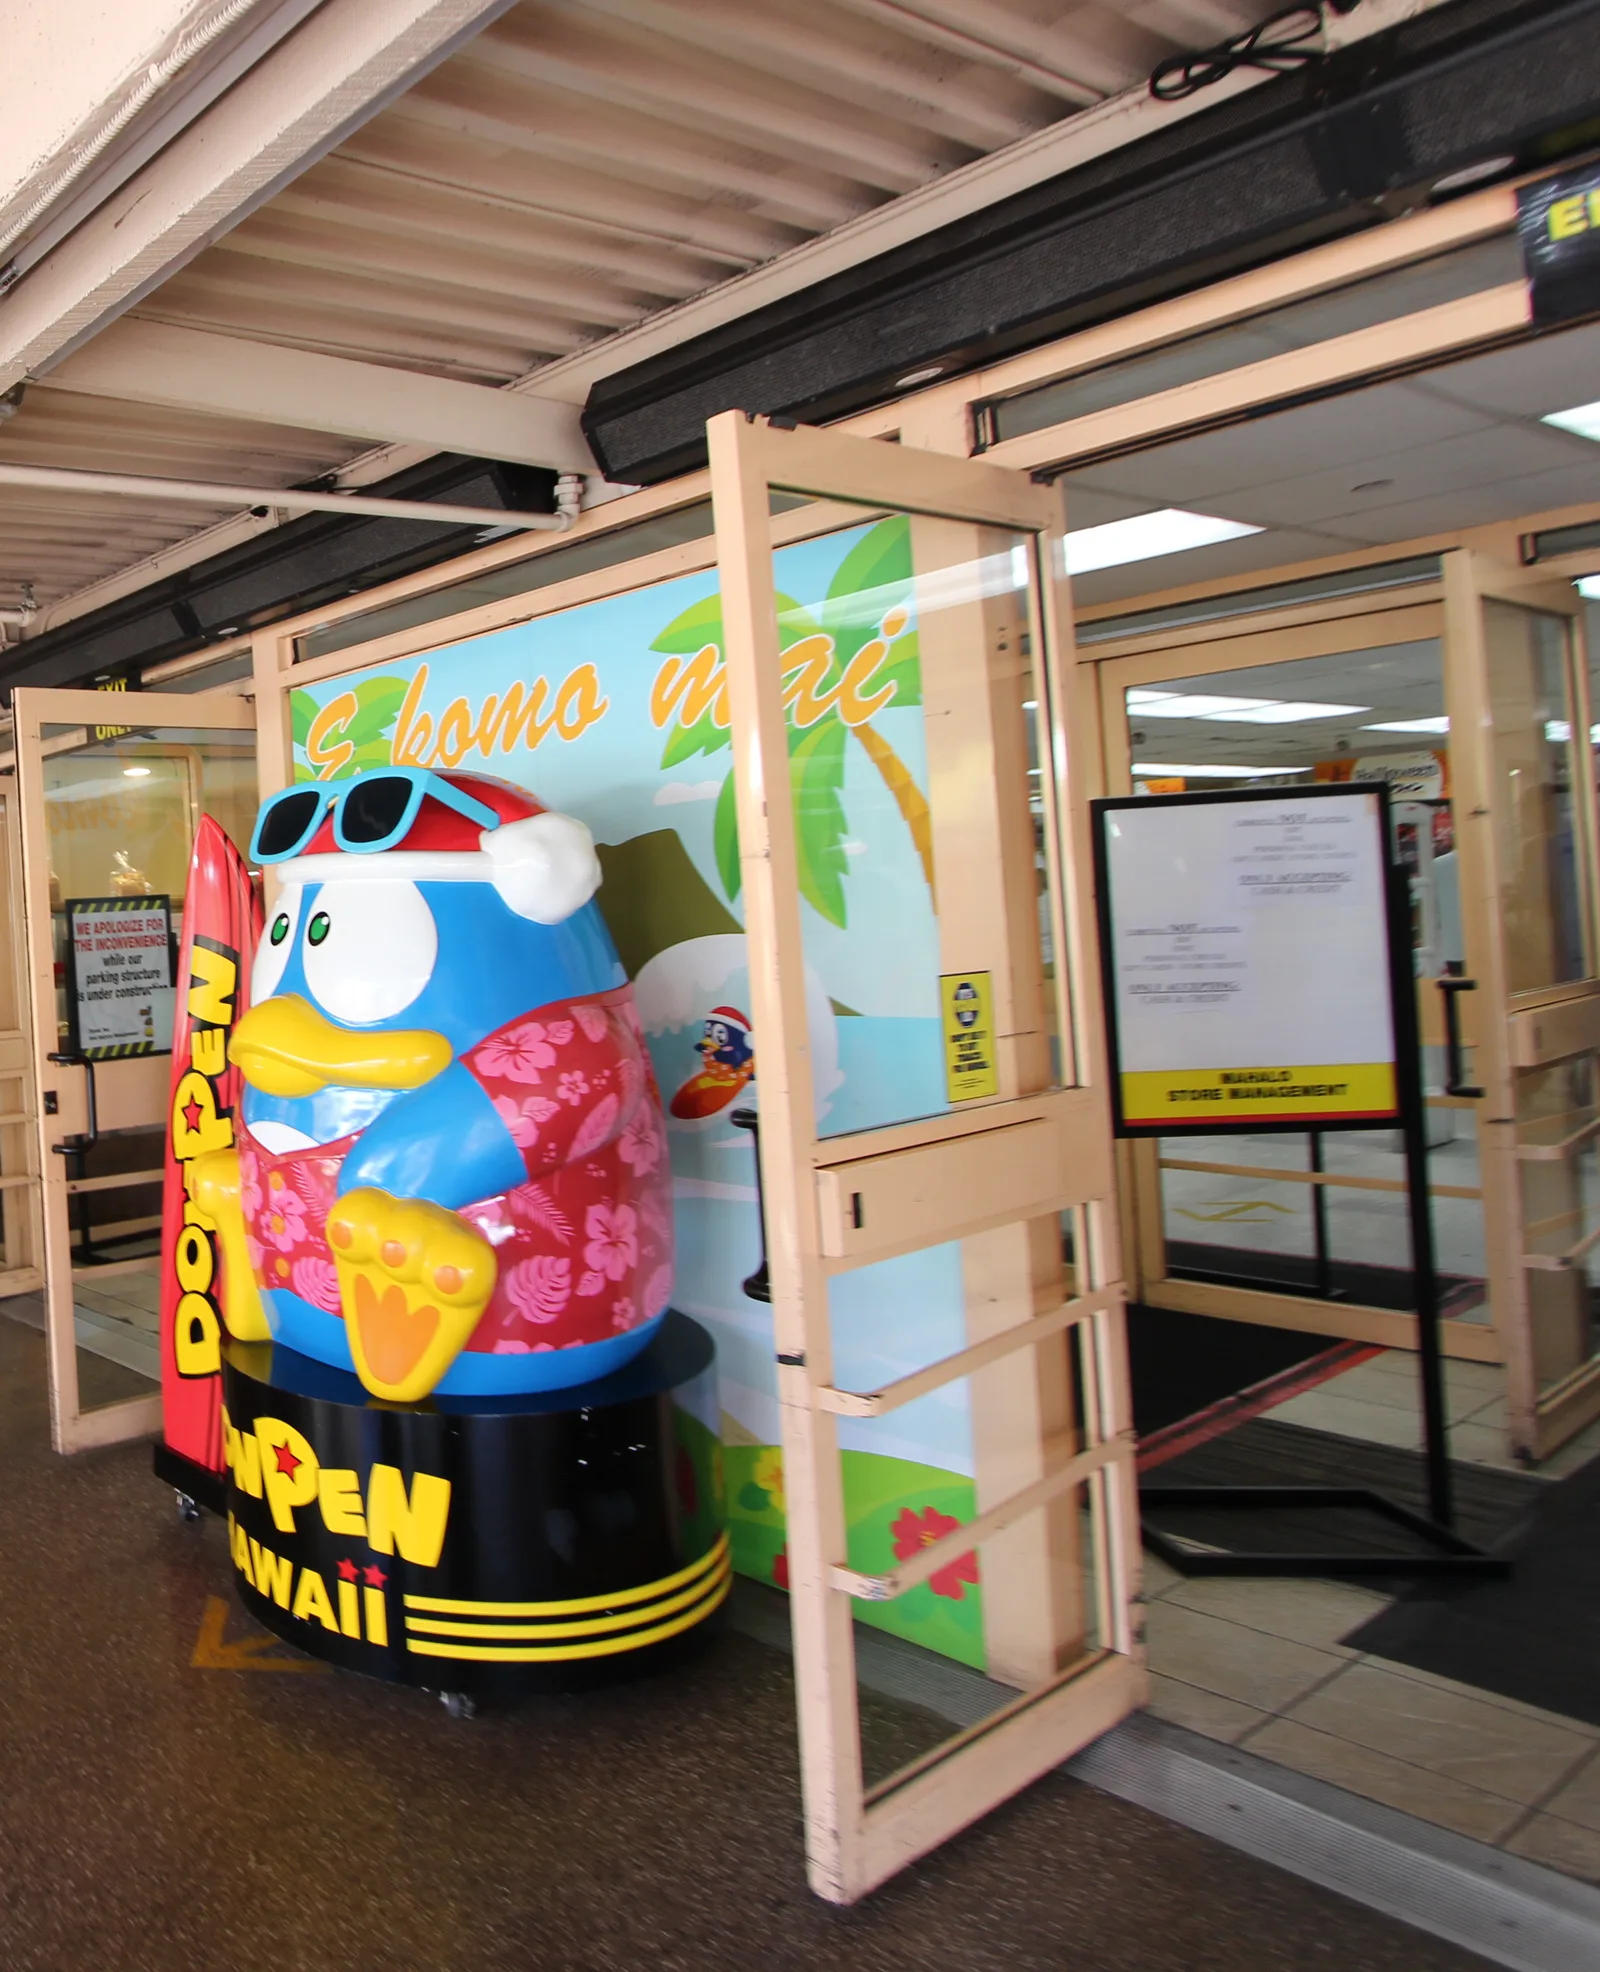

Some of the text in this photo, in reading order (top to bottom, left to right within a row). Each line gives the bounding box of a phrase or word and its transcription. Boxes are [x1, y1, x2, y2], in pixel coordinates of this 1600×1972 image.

[391, 662, 609, 768] komo
[75, 918, 164, 936] WE APOLOGIZE FOR
[74, 934, 167, 952] THE INCONVENIENCE
[102, 953, 143, 967] while our
[86, 968, 161, 986] parking structure
[87, 988, 113, 1001] under
[1221, 1070, 1293, 1084] MAHALO
[1167, 1084, 1348, 1102] STORE MANAGEMENT
